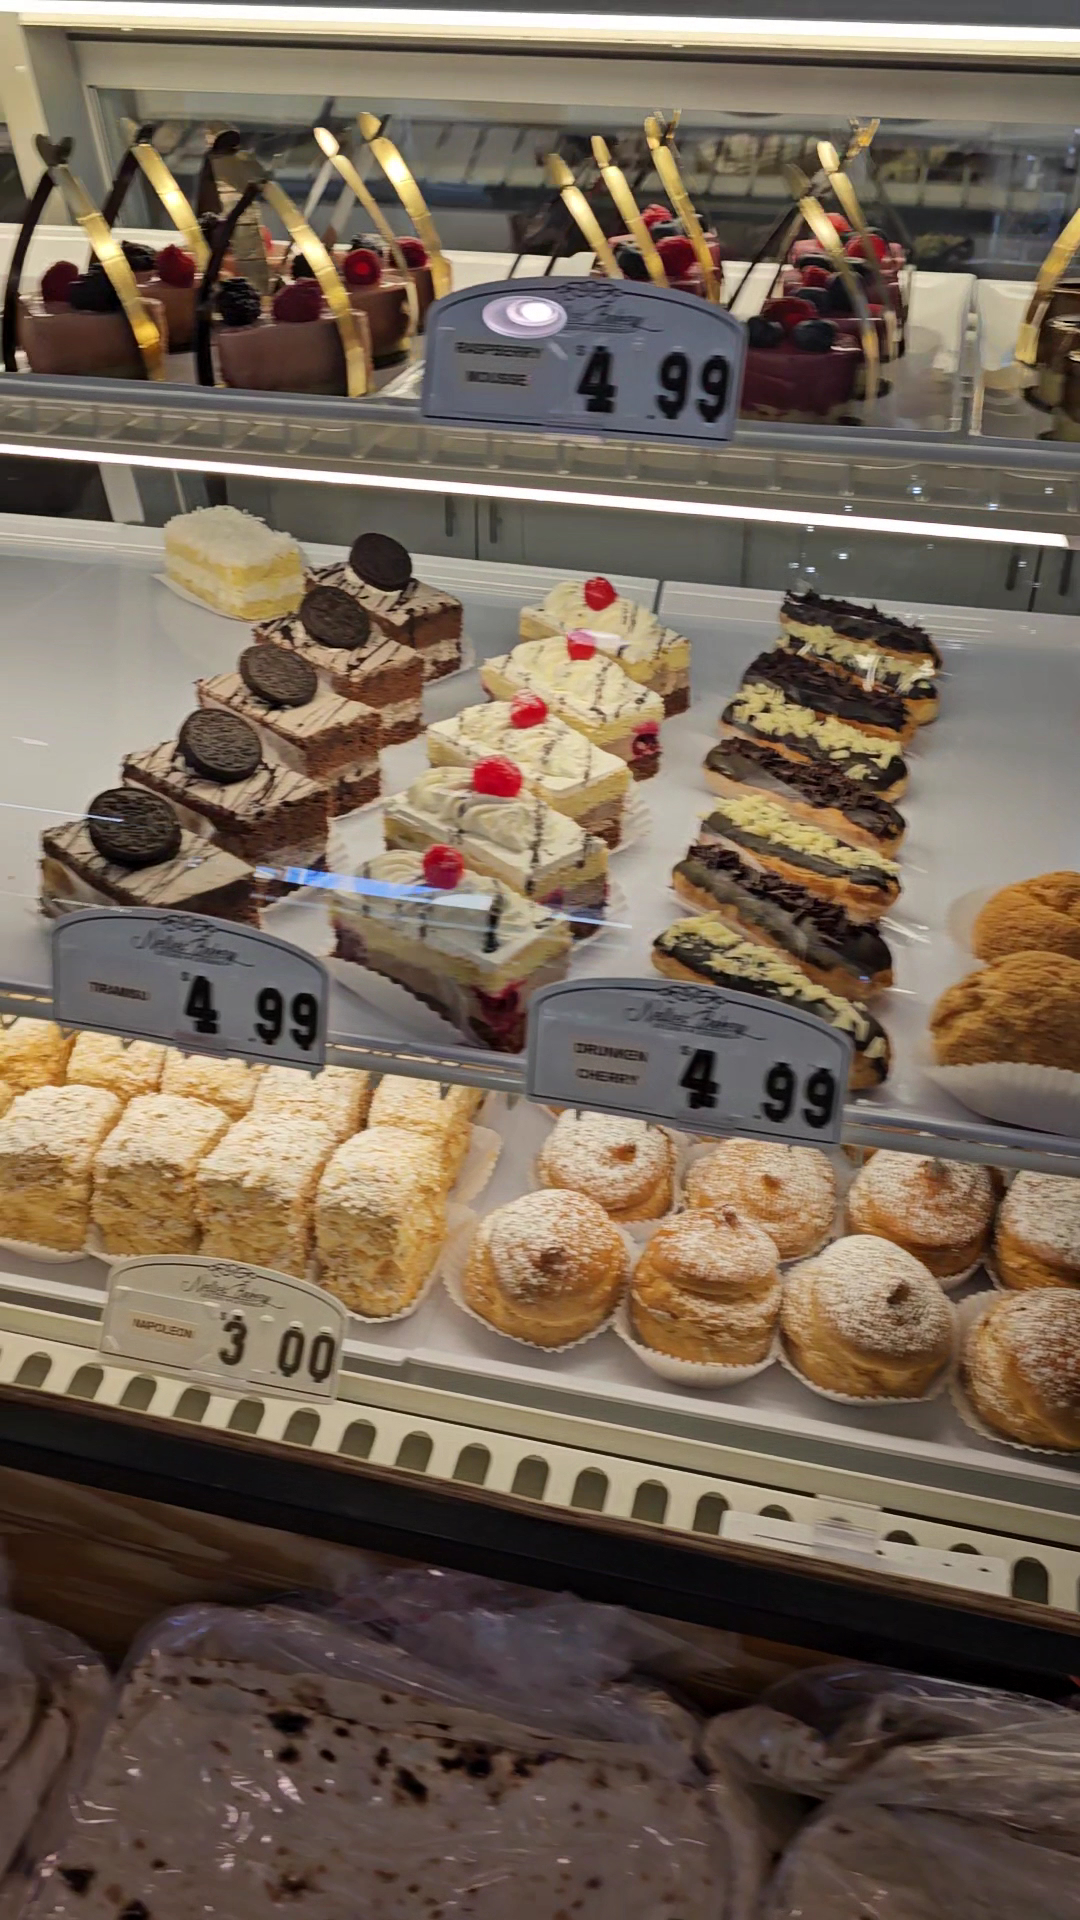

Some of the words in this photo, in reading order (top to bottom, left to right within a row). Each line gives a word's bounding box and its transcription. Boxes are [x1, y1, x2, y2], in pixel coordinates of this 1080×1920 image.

[574, 1042, 648, 1063] DRUNKEN
[576, 1068, 640, 1086] CHERRY
[133, 1318, 194, 1339] NAPOLEON
